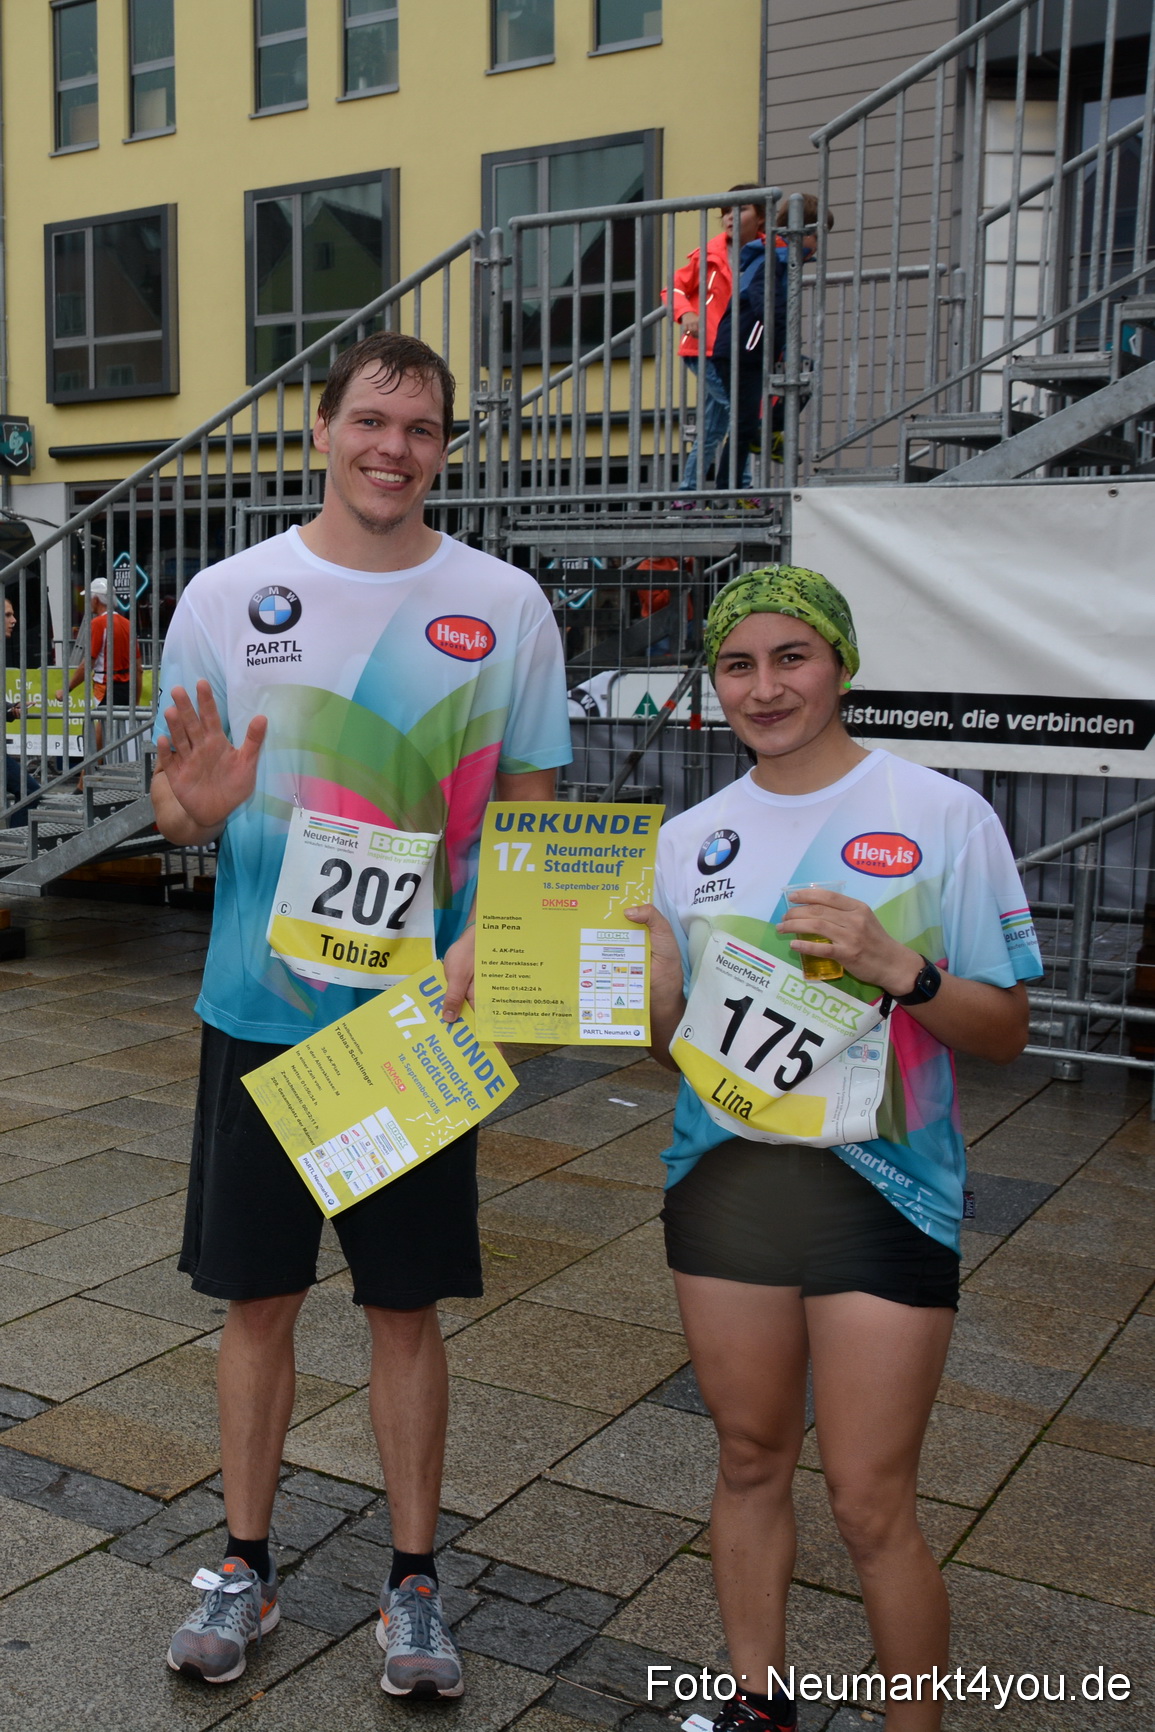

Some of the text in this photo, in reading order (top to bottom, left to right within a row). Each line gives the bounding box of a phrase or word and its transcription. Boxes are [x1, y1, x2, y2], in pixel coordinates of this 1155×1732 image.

[253, 586, 297, 604] BMW
[246, 640, 302, 656] PARTL
[436, 623, 488, 651] Hervis
[440, 642, 467, 651] SPORTS
[246, 653, 302, 667] Neumarkt
[841, 705, 1134, 735] eistungen, die verbinden
[494, 812, 652, 835] URKUNDE
[303, 829, 359, 849] NeuerMarkt
[545, 843, 646, 859] Neumarkter
[702, 831, 738, 850] BMW
[493, 842, 536, 872] 17.
[853, 842, 914, 866] Hervis
[856, 860, 887, 868] SPORTS
[543, 859, 625, 877] Stadtlauf
[311, 858, 422, 931] 202
[543, 882, 620, 891] 18. September 2016
[692, 890, 734, 905] eumarkt
[541, 898, 570, 908] DKMS
[501, 923, 521, 931] Pena
[596, 931, 630, 940] BOCK
[320, 934, 391, 968] Tobias
[716, 954, 771, 988] NeuerMarkt
[779, 974, 865, 1031] BOCK
[388, 993, 427, 1040] 17.
[334, 1026, 350, 1049] Tobias
[342, 1022, 363, 1055] Halbmarathon
[719, 995, 825, 1092] 175
[299, 1055, 309, 1069] einer
[307, 1068, 316, 1080] Zeit
[309, 1050, 317, 1059] der
[315, 1059, 337, 1092] Altersklasse:
[383, 1061, 402, 1086] DKMS
[411, 1042, 461, 1107] Stadtlauf
[425, 1033, 481, 1112] Neumarkter
[398, 1053, 441, 1115] 18. September 2016
[711, 1078, 754, 1120] Lina
[302, 1157, 330, 1199] PARTL Neumarkt
